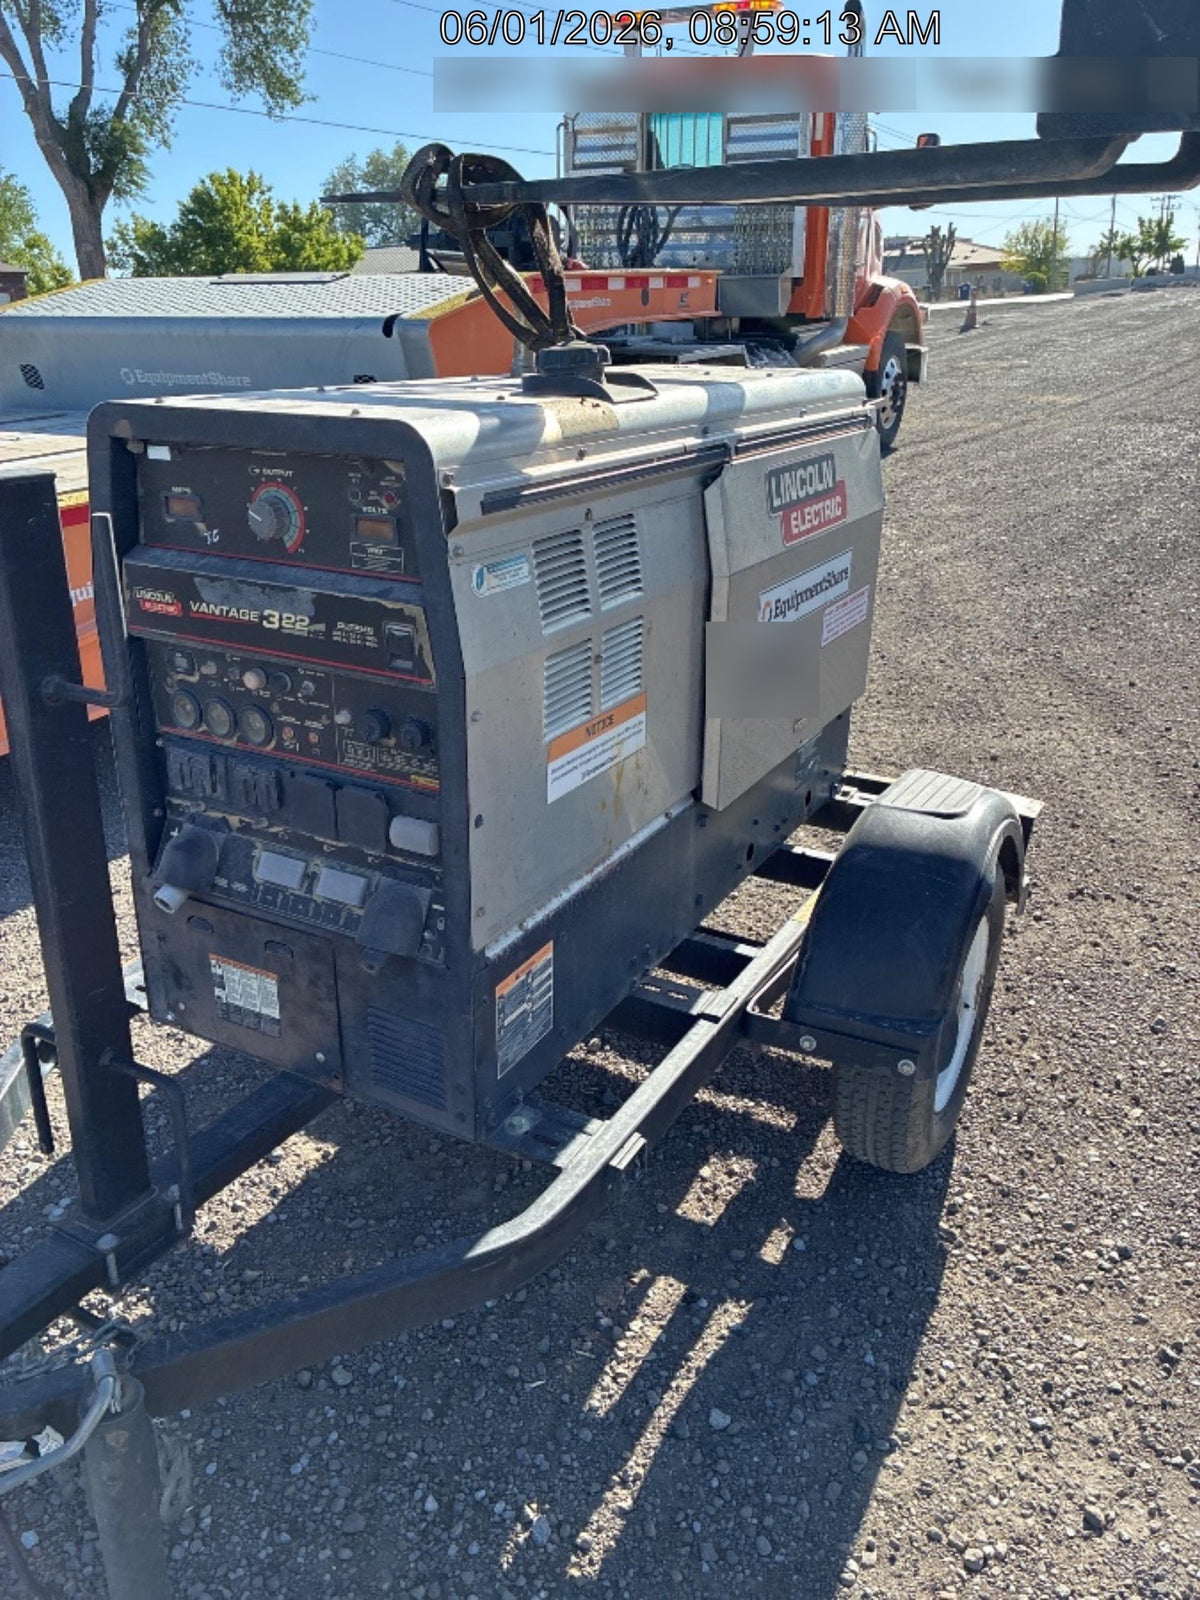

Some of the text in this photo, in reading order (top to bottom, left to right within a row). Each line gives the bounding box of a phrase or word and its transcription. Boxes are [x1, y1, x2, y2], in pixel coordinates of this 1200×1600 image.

[135, 368, 251, 387] EquipmentShare
[771, 459, 833, 508] LINCOLN
[790, 495, 842, 535] ELECTRIC
[774, 566, 849, 619] EquipmentShare
[189, 600, 311, 631] VANTAGE 322
[585, 713, 615, 738] NOTICE
